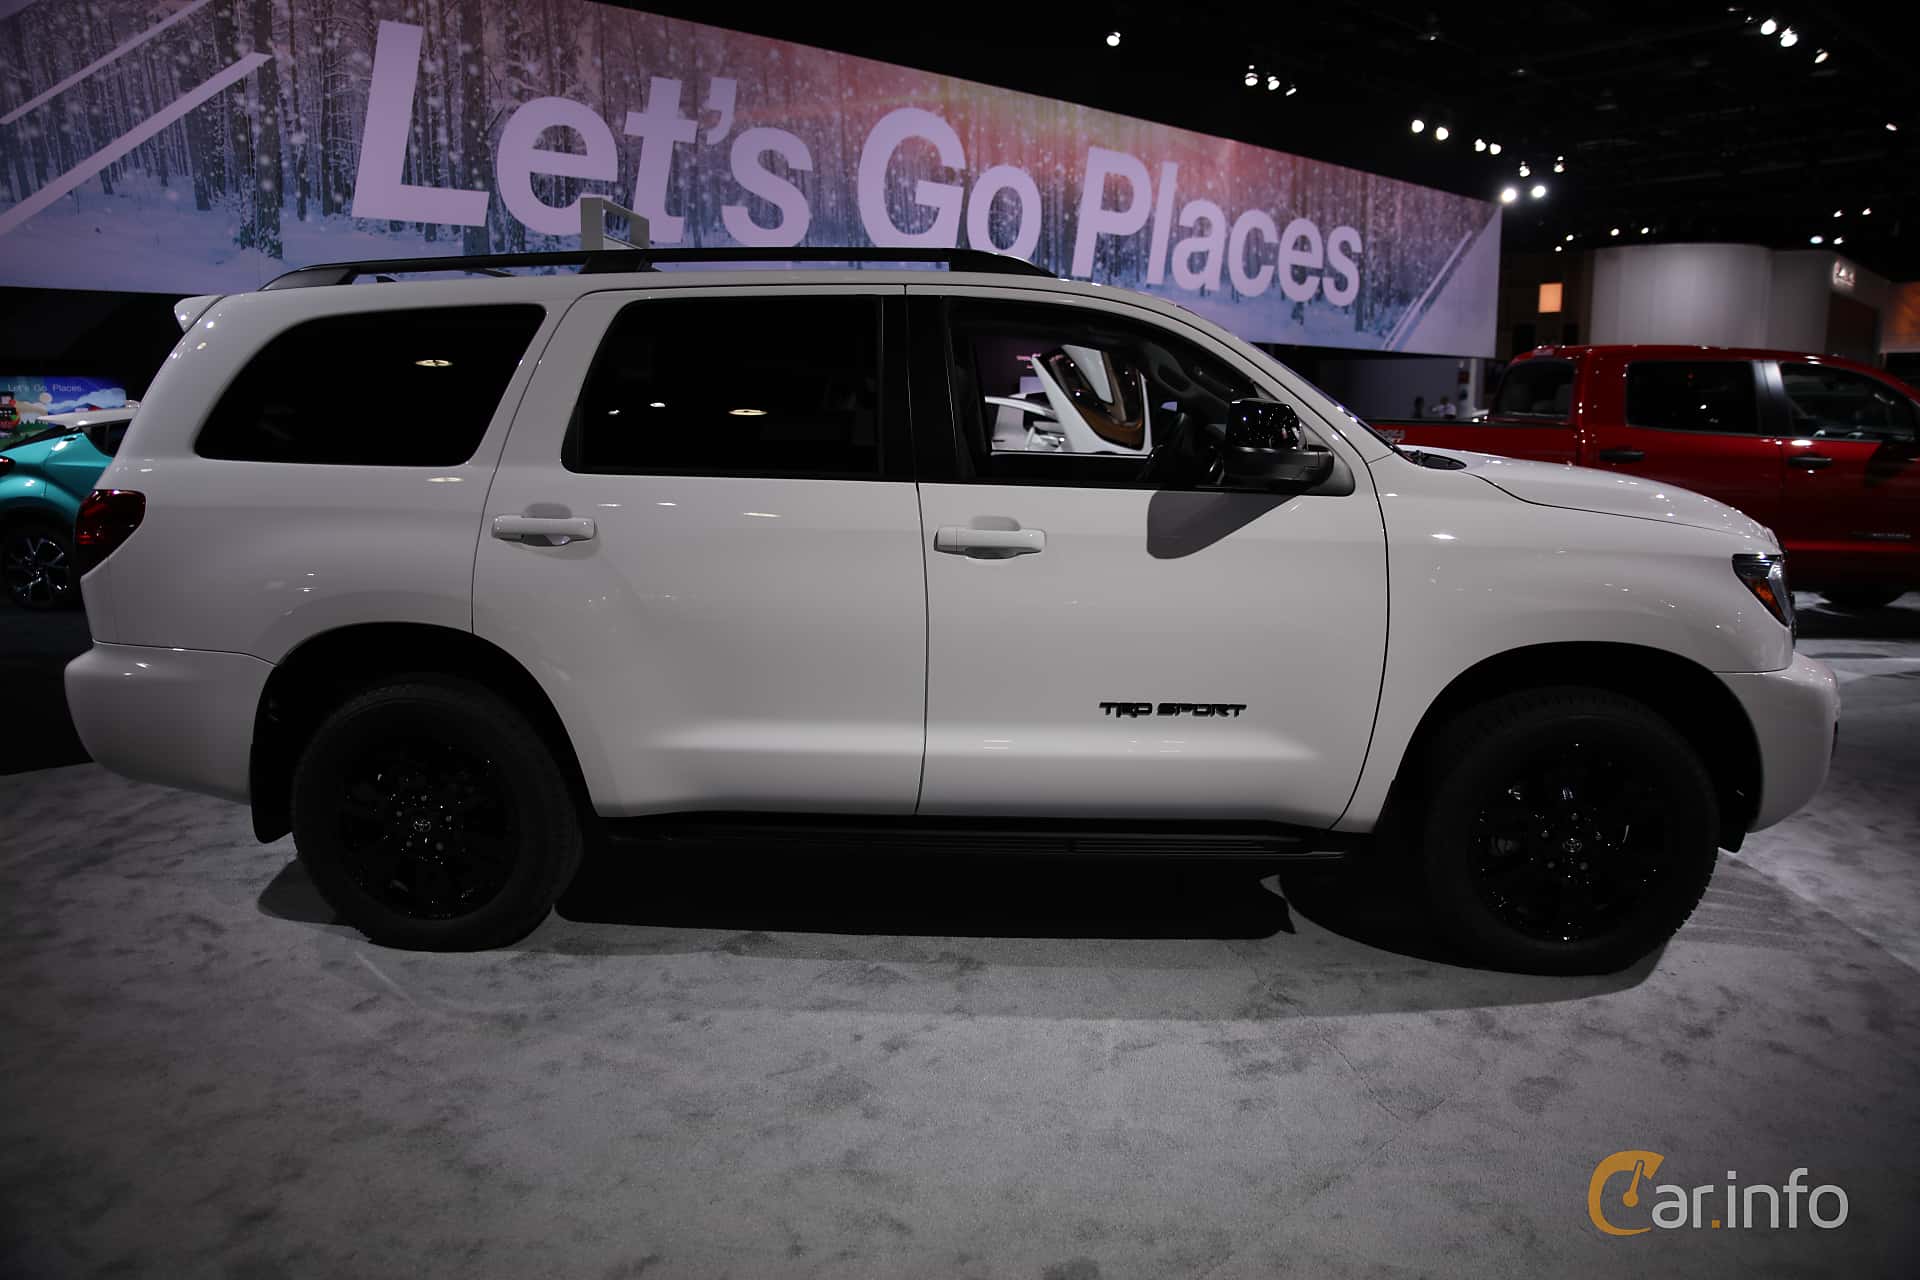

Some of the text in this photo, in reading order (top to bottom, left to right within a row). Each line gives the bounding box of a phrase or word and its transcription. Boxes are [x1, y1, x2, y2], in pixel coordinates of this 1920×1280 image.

[352, 20, 1362, 306] Let's Go Places
[1099, 702, 1247, 718] TRD SPORT
